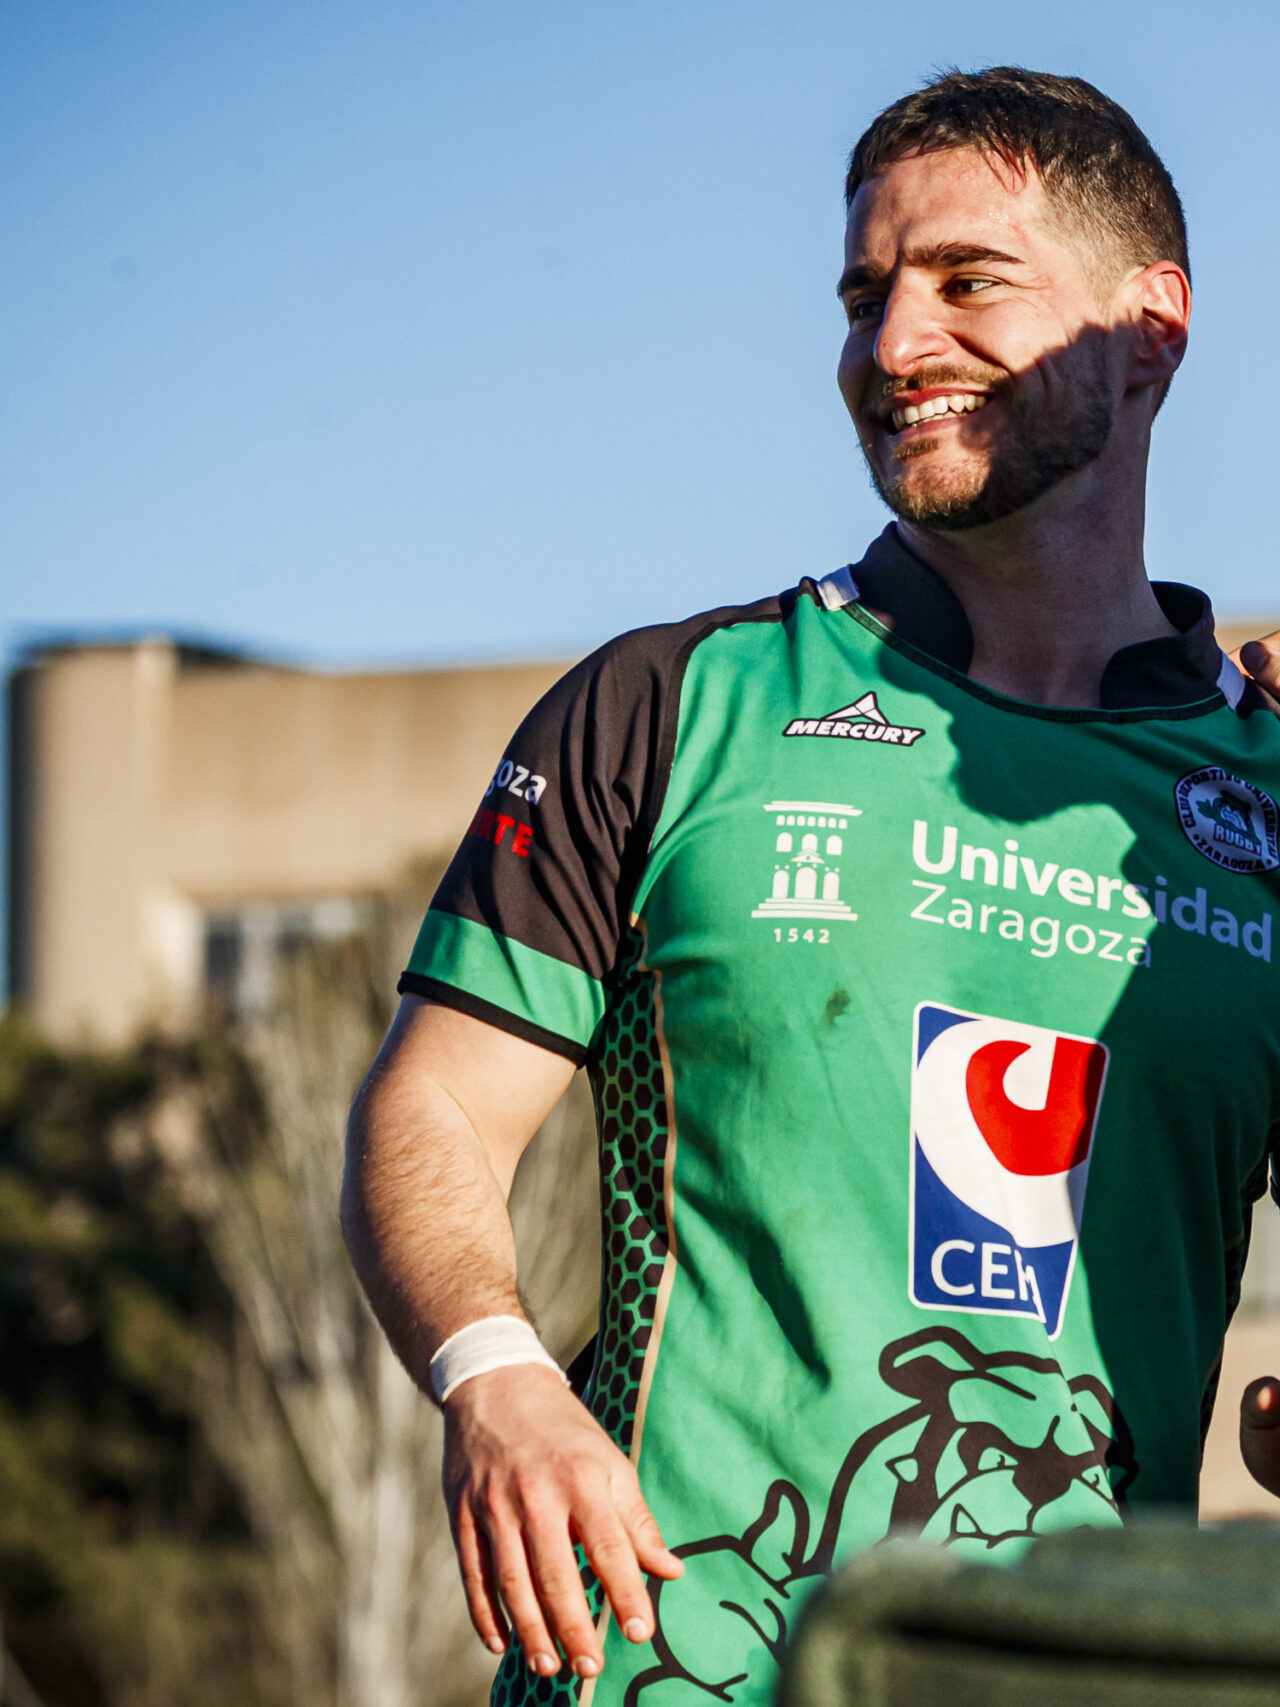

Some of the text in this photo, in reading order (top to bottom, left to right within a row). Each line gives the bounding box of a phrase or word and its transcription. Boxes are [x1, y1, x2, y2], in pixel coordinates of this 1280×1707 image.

[784, 719, 924, 746] MERCURY
[1196, 838, 1265, 870] ZARAGOZA
[913, 820, 1272, 963] Universidad
[773, 927, 830, 944] 1542
[910, 879, 1152, 968] Zaragoza
